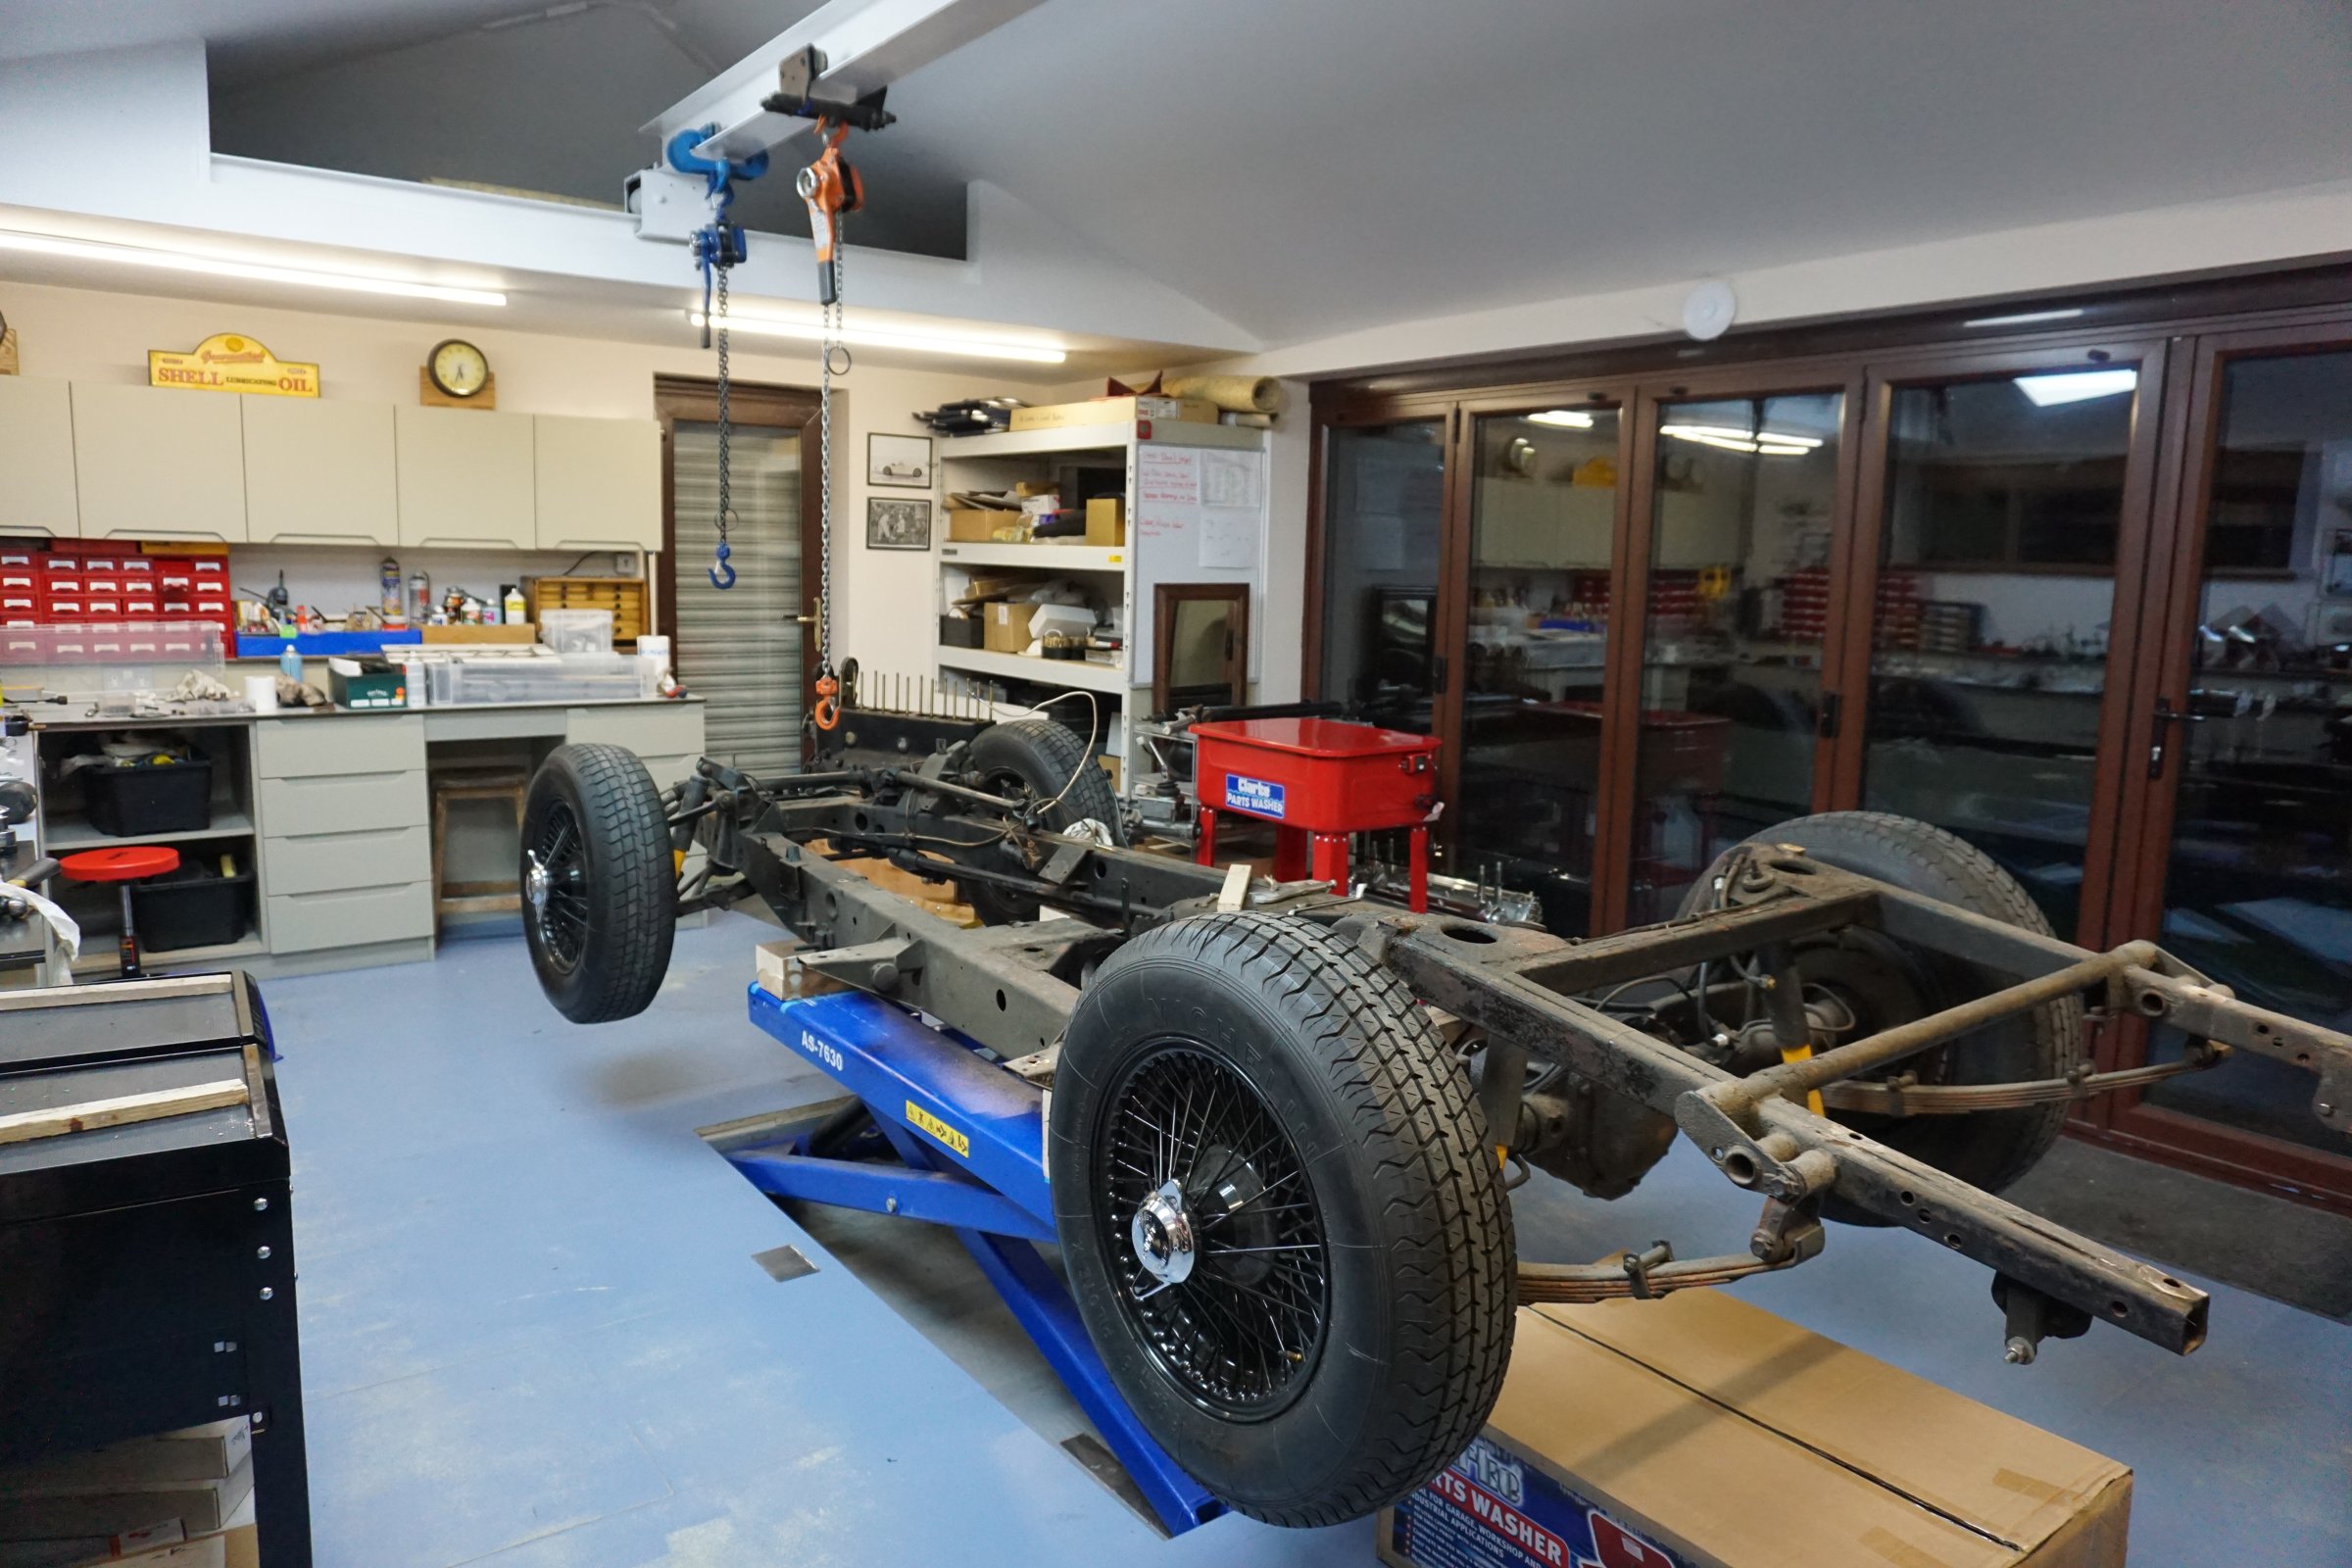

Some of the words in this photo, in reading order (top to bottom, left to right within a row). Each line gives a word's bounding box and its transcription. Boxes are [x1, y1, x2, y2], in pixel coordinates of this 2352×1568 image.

[158, 368, 224, 386] SHELL
[278, 377, 313, 392] OIL
[1227, 792, 1250, 808] PARTS
[1250, 798, 1283, 814] WASHER
[802, 1030, 843, 1071] AS-7630
[1412, 1493, 1449, 1522] DUSTRIAL
[1450, 1517, 1504, 1558] APPLICATIONS
[1429, 1492, 1444, 1507] FOR
[1479, 1524, 1524, 1559] WORKSHOP
[1471, 1490, 1563, 1566] WASHER
